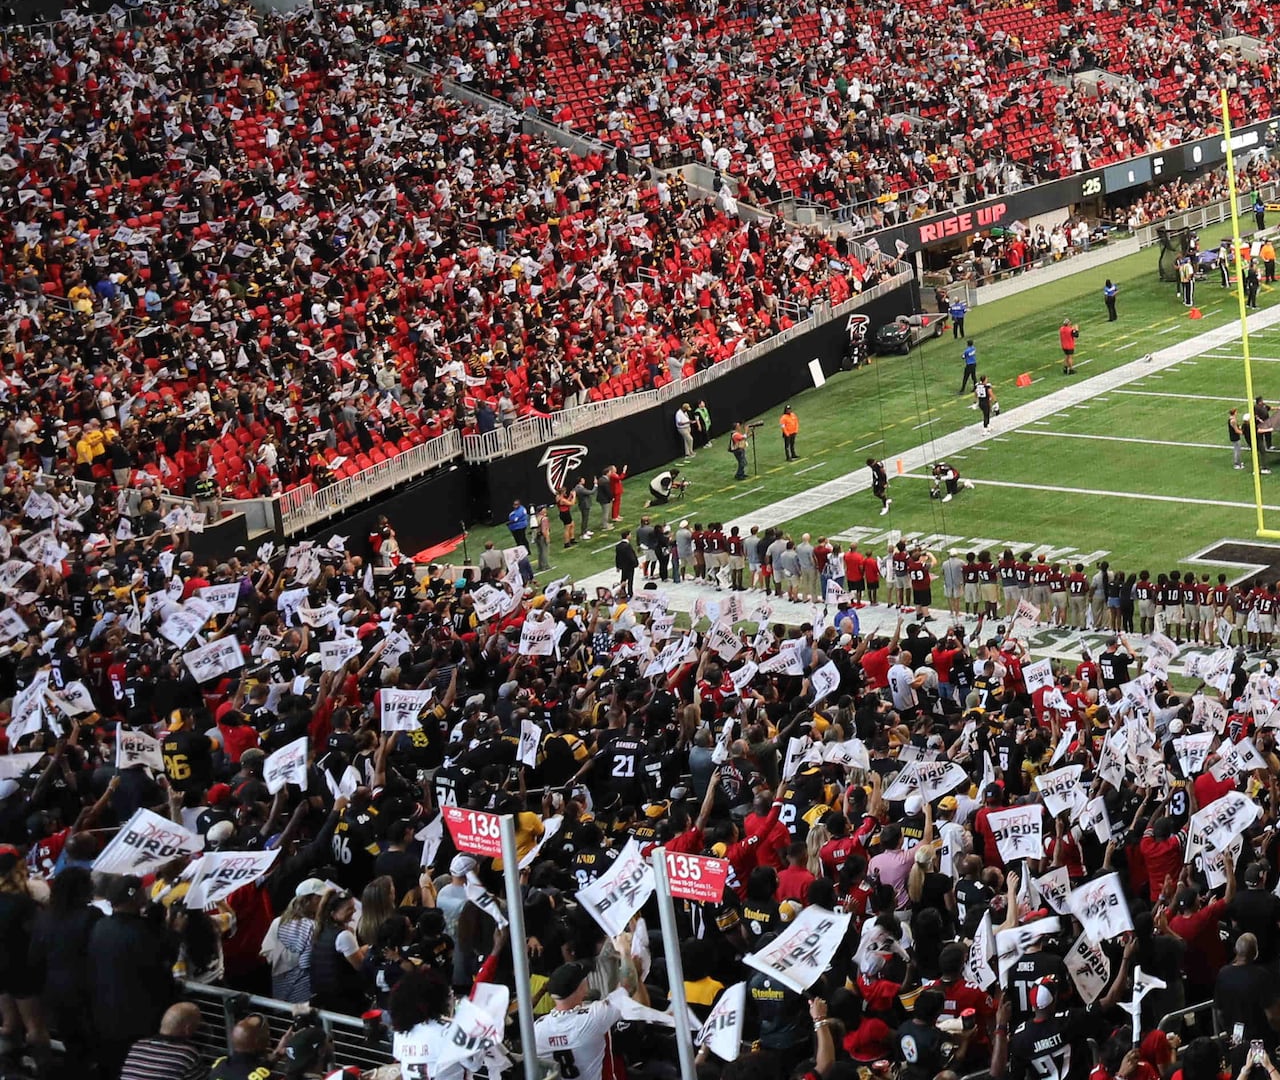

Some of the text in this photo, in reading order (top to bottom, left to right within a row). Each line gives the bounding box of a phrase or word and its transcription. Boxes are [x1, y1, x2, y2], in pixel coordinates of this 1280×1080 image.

[1082, 177, 1102, 196] :25
[919, 203, 1007, 243] RISE UP
[394, 585, 406, 599] 22
[1070, 582, 1083, 593] 47
[520, 633, 551, 644] BIRDS
[384, 702, 425, 713] BIRDS
[612, 754, 635, 777] 21
[468, 812, 500, 839] 136
[997, 813, 1034, 829] DIRTY
[1202, 798, 1247, 835] BIRDS
[142, 821, 189, 846] DIRTY
[993, 821, 1040, 840] BIRDS
[122, 830, 192, 858] BIRDS
[221, 855, 259, 870] DIRTY
[667, 853, 701, 880] 135
[743, 907, 770, 923] Steelers
[769, 919, 833, 973] BIRDS
[1017, 962, 1035, 972] JONES
[752, 988, 784, 1000] Steelers
[547, 1035, 568, 1047] PITTS
[1033, 1035, 1062, 1054] JARRETT
[1031, 1047, 1072, 1080] 97
